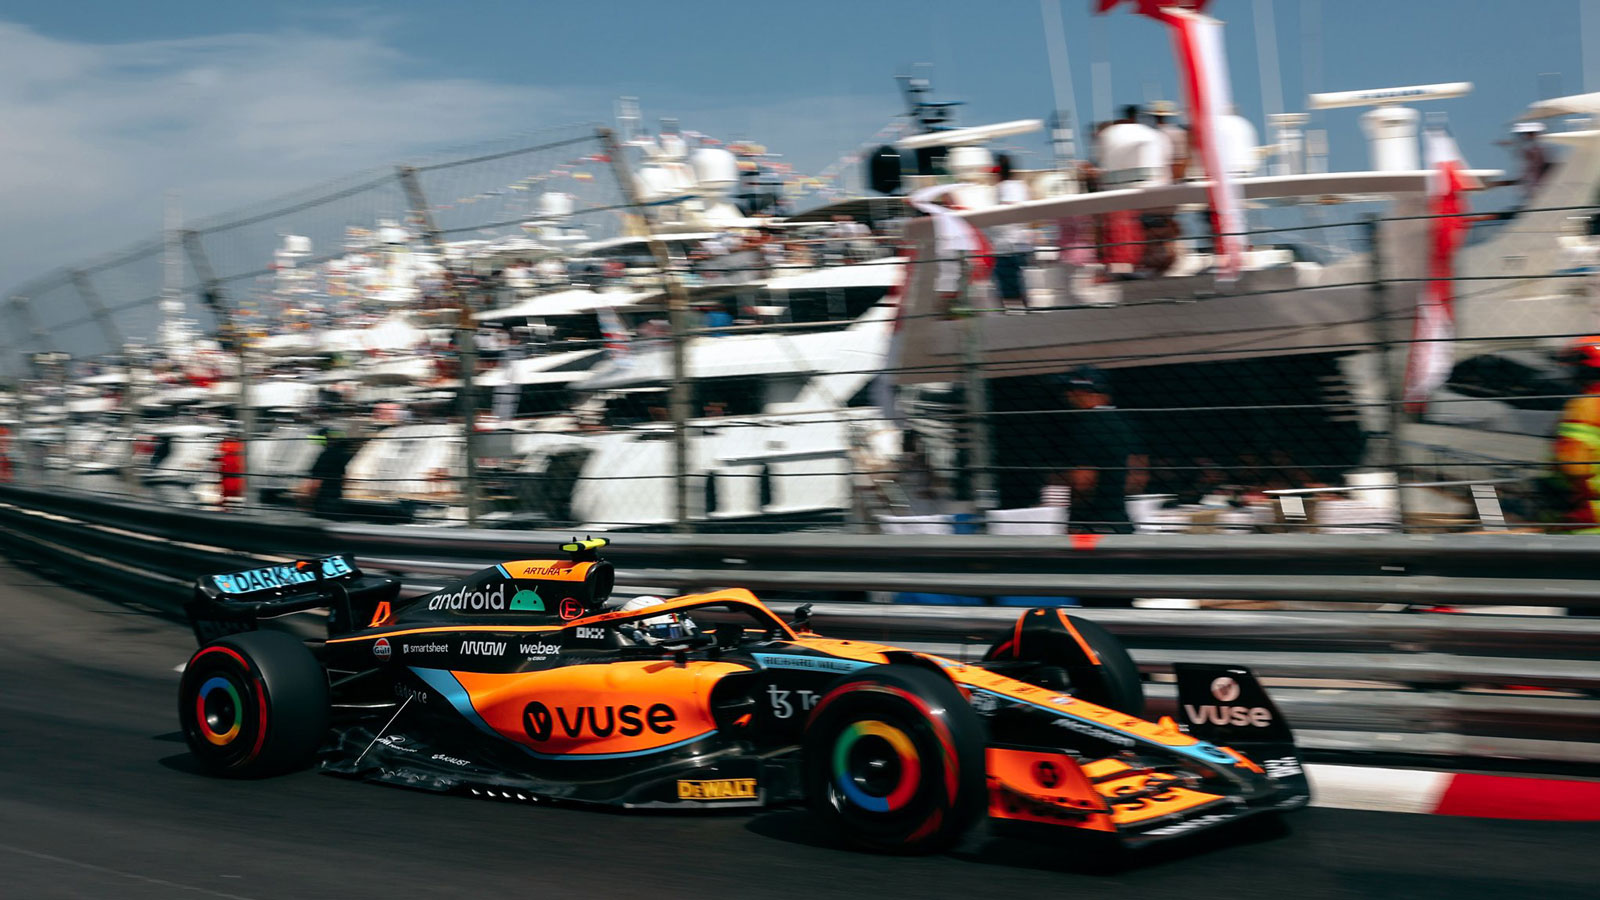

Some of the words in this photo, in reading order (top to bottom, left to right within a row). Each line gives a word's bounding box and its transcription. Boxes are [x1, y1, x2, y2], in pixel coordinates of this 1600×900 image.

[232, 557, 347, 591] DARKCE
[523, 566, 560, 576] ARTURA
[428, 583, 505, 611] android
[564, 601, 577, 619] E
[576, 627, 605, 639] OKX
[410, 642, 448, 653] smartsheet
[460, 640, 507, 656] ARROW
[520, 641, 561, 655] webex
[556, 703, 677, 738] vuse
[1183, 704, 1273, 728] vuse
